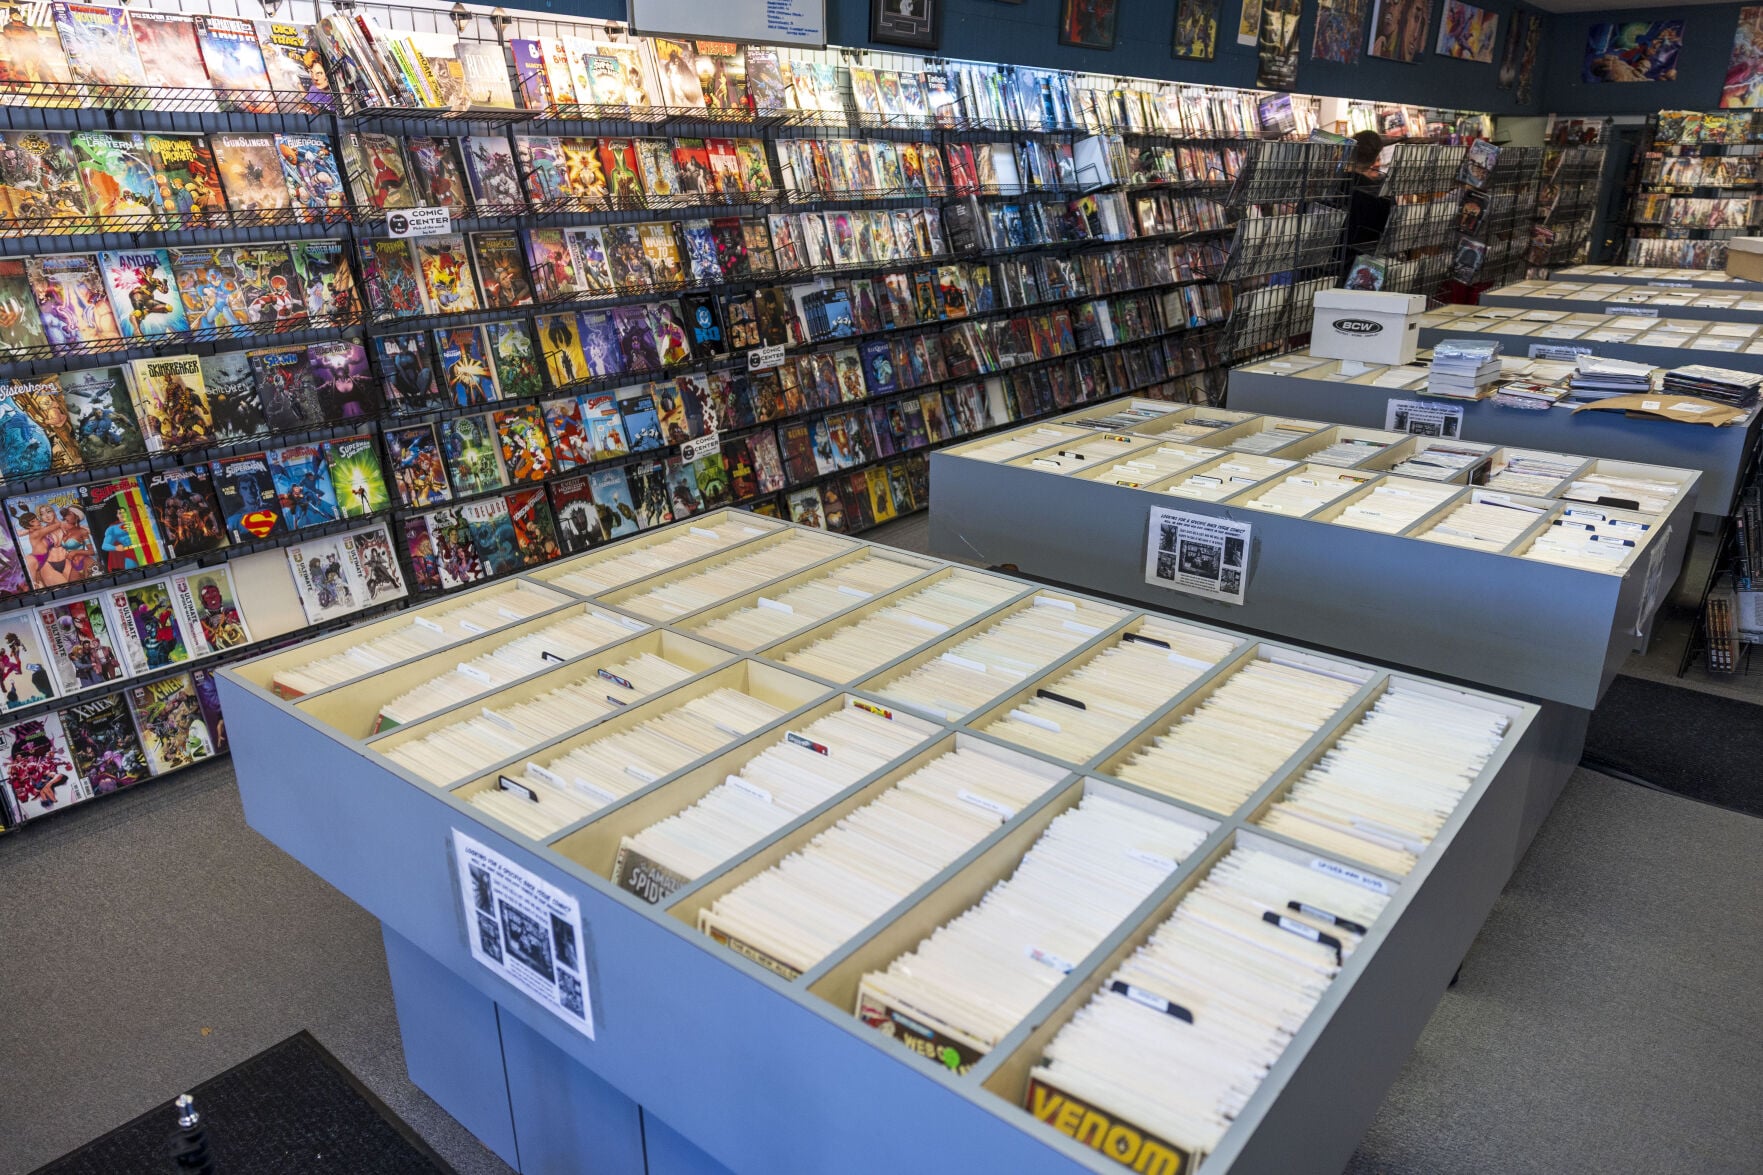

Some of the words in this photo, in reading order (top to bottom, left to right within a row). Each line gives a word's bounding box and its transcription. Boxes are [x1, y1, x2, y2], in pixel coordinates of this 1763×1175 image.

[271, 24, 298, 36] DICK
[271, 35, 304, 46] TRACY
[77, 133, 113, 141] GREEN
[87, 139, 133, 149] LANTERN
[412, 209, 444, 217] COMIC
[409, 217, 449, 226] CENTER
[647, 225, 665, 237] THE
[643, 236, 675, 248] WORLD
[657, 247, 668, 258] TO
[1342, 321, 1374, 331] BCW
[763, 346, 781, 354] COMIC
[264, 352, 298, 368] SPAWN
[761, 352, 784, 361] CENTER
[147, 360, 200, 377] SKINBREAKER
[695, 435, 716, 444] COMIC
[694, 440, 719, 452] CENTER
[225, 460, 268, 478] SUPERMAN
[90, 479, 140, 503] SUPERMAN
[350, 549, 364, 578] ULTIMATE
[299, 562, 313, 593] ULTIMATE
[184, 592, 198, 623] ULTIMATE
[123, 607, 138, 640] ULTIMATE
[51, 623, 67, 657] ULTIMATE
[147, 676, 185, 700] X-MEN
[71, 698, 116, 721] X-MEN
[903, 1032, 936, 1059] WEB
[1032, 1086, 1181, 1175] VENOM
